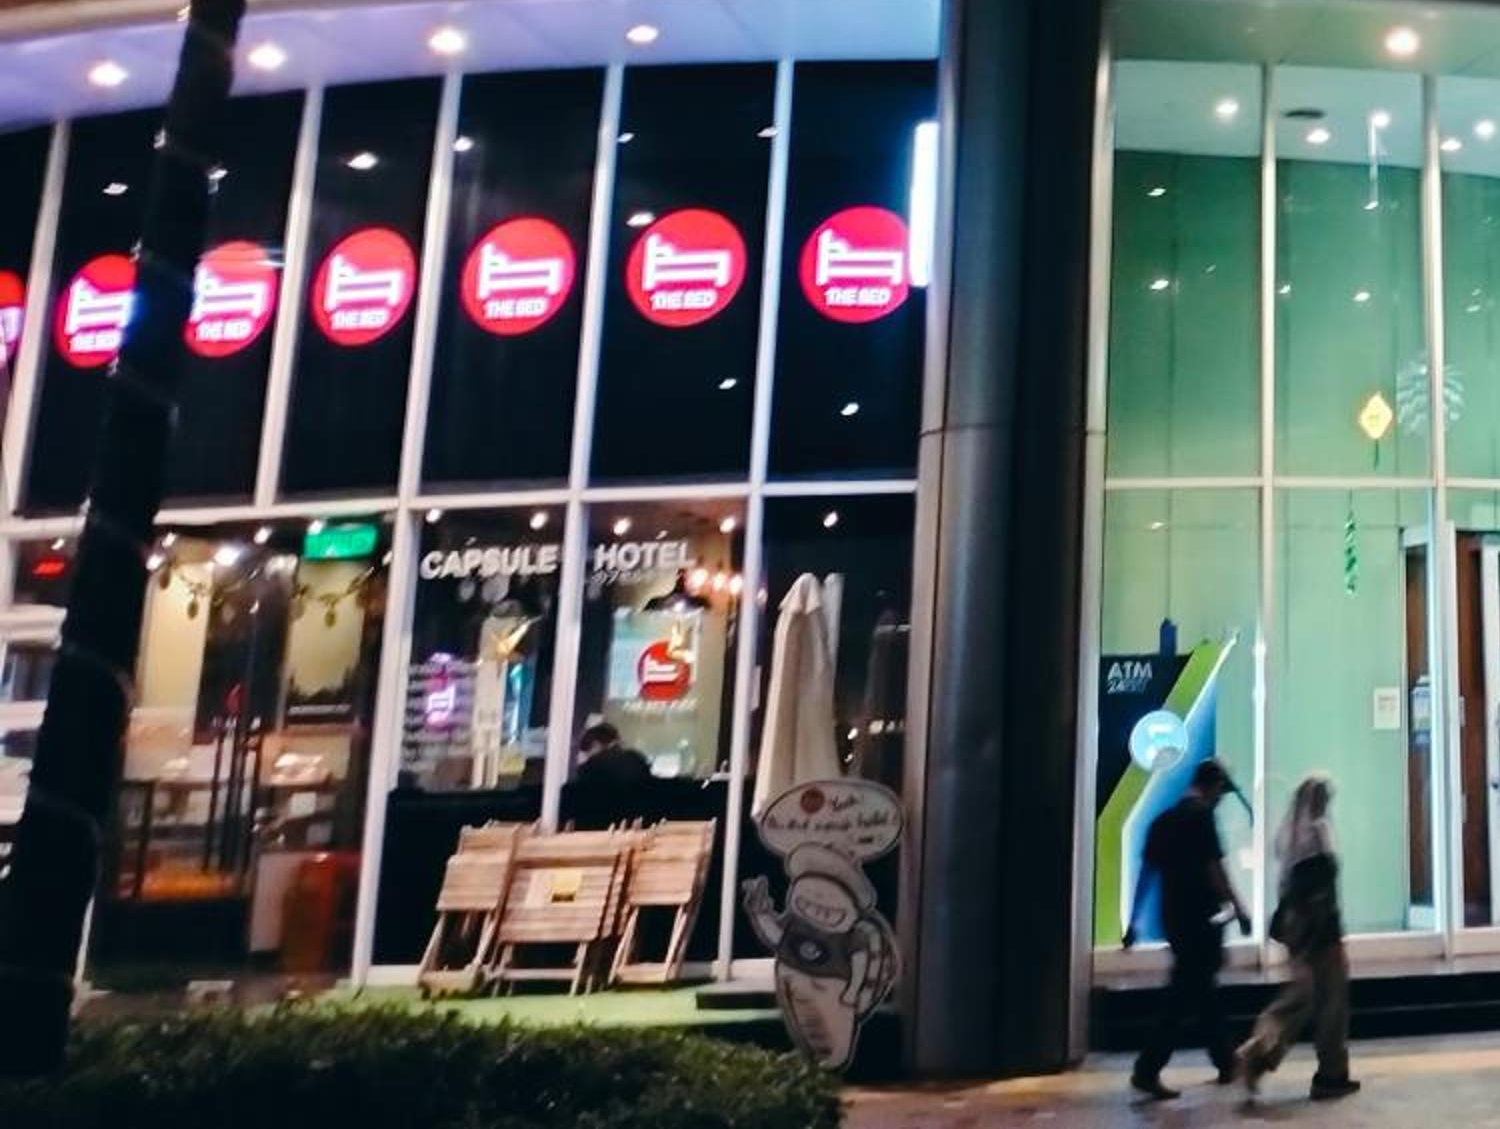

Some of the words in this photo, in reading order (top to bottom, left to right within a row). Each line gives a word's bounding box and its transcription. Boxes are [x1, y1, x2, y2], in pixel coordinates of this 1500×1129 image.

[651, 291, 682, 310] THE
[683, 290, 717, 309] BED
[824, 287, 857, 305] THE
[858, 287, 891, 305] BED
[484, 300, 514, 319] THE
[420, 544, 559, 579] CAPSULE
[594, 541, 696, 571] HOTEL
[1107, 661, 1153, 680] ATM
